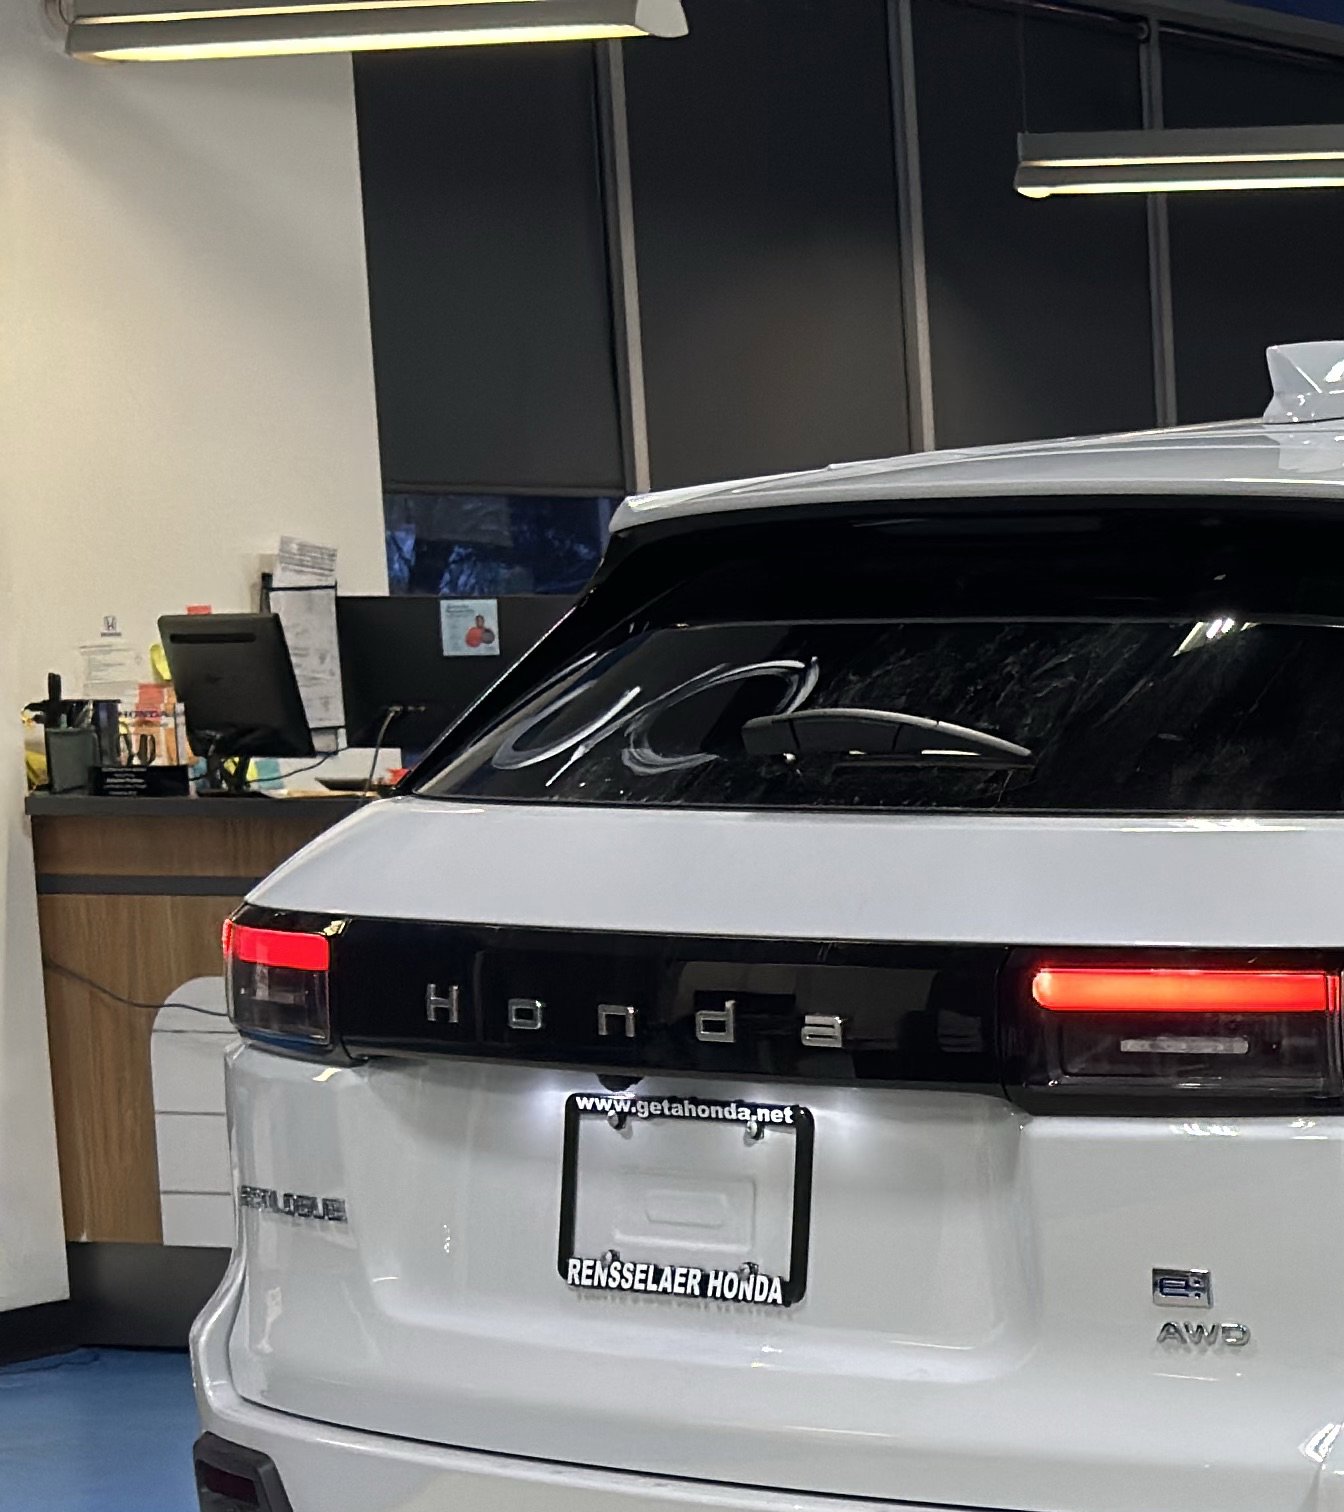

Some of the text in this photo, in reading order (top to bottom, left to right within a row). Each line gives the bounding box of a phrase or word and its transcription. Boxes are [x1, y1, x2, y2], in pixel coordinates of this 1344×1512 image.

[425, 983, 849, 1049] Honda
[575, 1096, 794, 1124] www.getahonda.net
[567, 1257, 784, 1305] RENSSELAER HONDA
[1156, 1320, 1252, 1347] AWD
